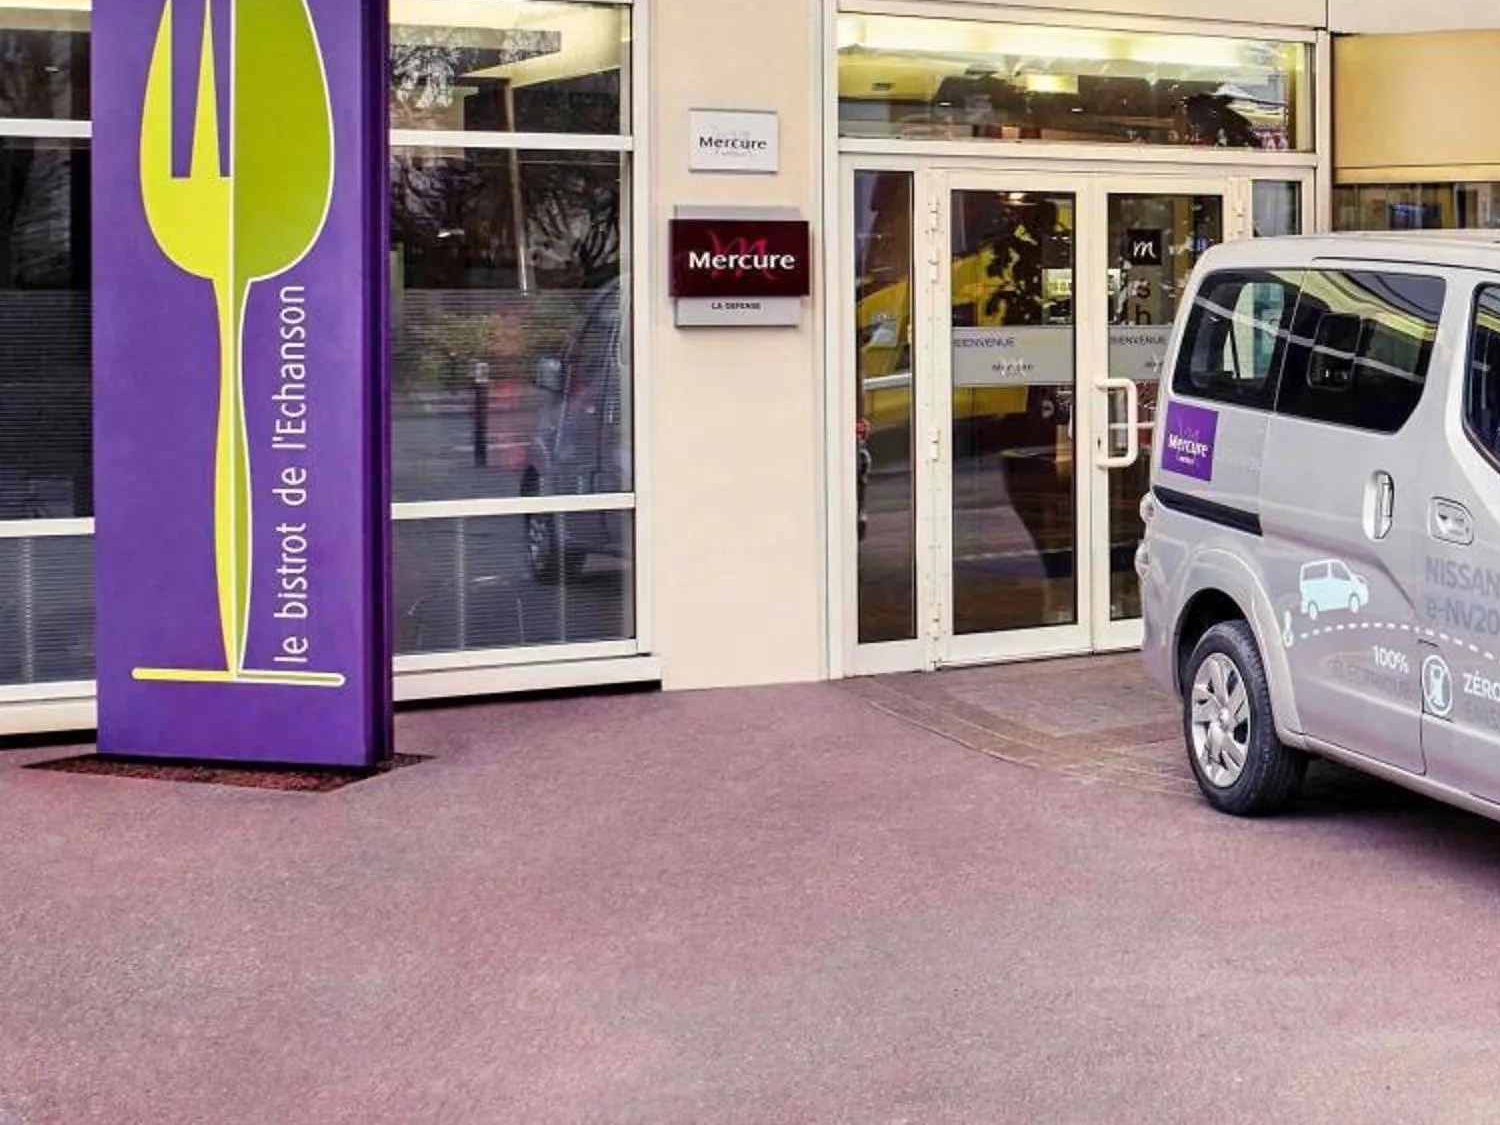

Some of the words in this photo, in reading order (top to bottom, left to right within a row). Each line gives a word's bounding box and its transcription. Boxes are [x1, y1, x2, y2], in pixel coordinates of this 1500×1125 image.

[699, 135, 768, 150] Mercure
[688, 250, 796, 270] Mercure
[271, 285, 307, 449] l'Echanson
[1168, 433, 1209, 458] Mercure
[272, 466, 307, 506] de
[273, 522, 308, 619] bistrot
[1425, 555, 1500, 598] NISSAN
[273, 635, 308, 663] le
[1371, 645, 1409, 675] 100%
